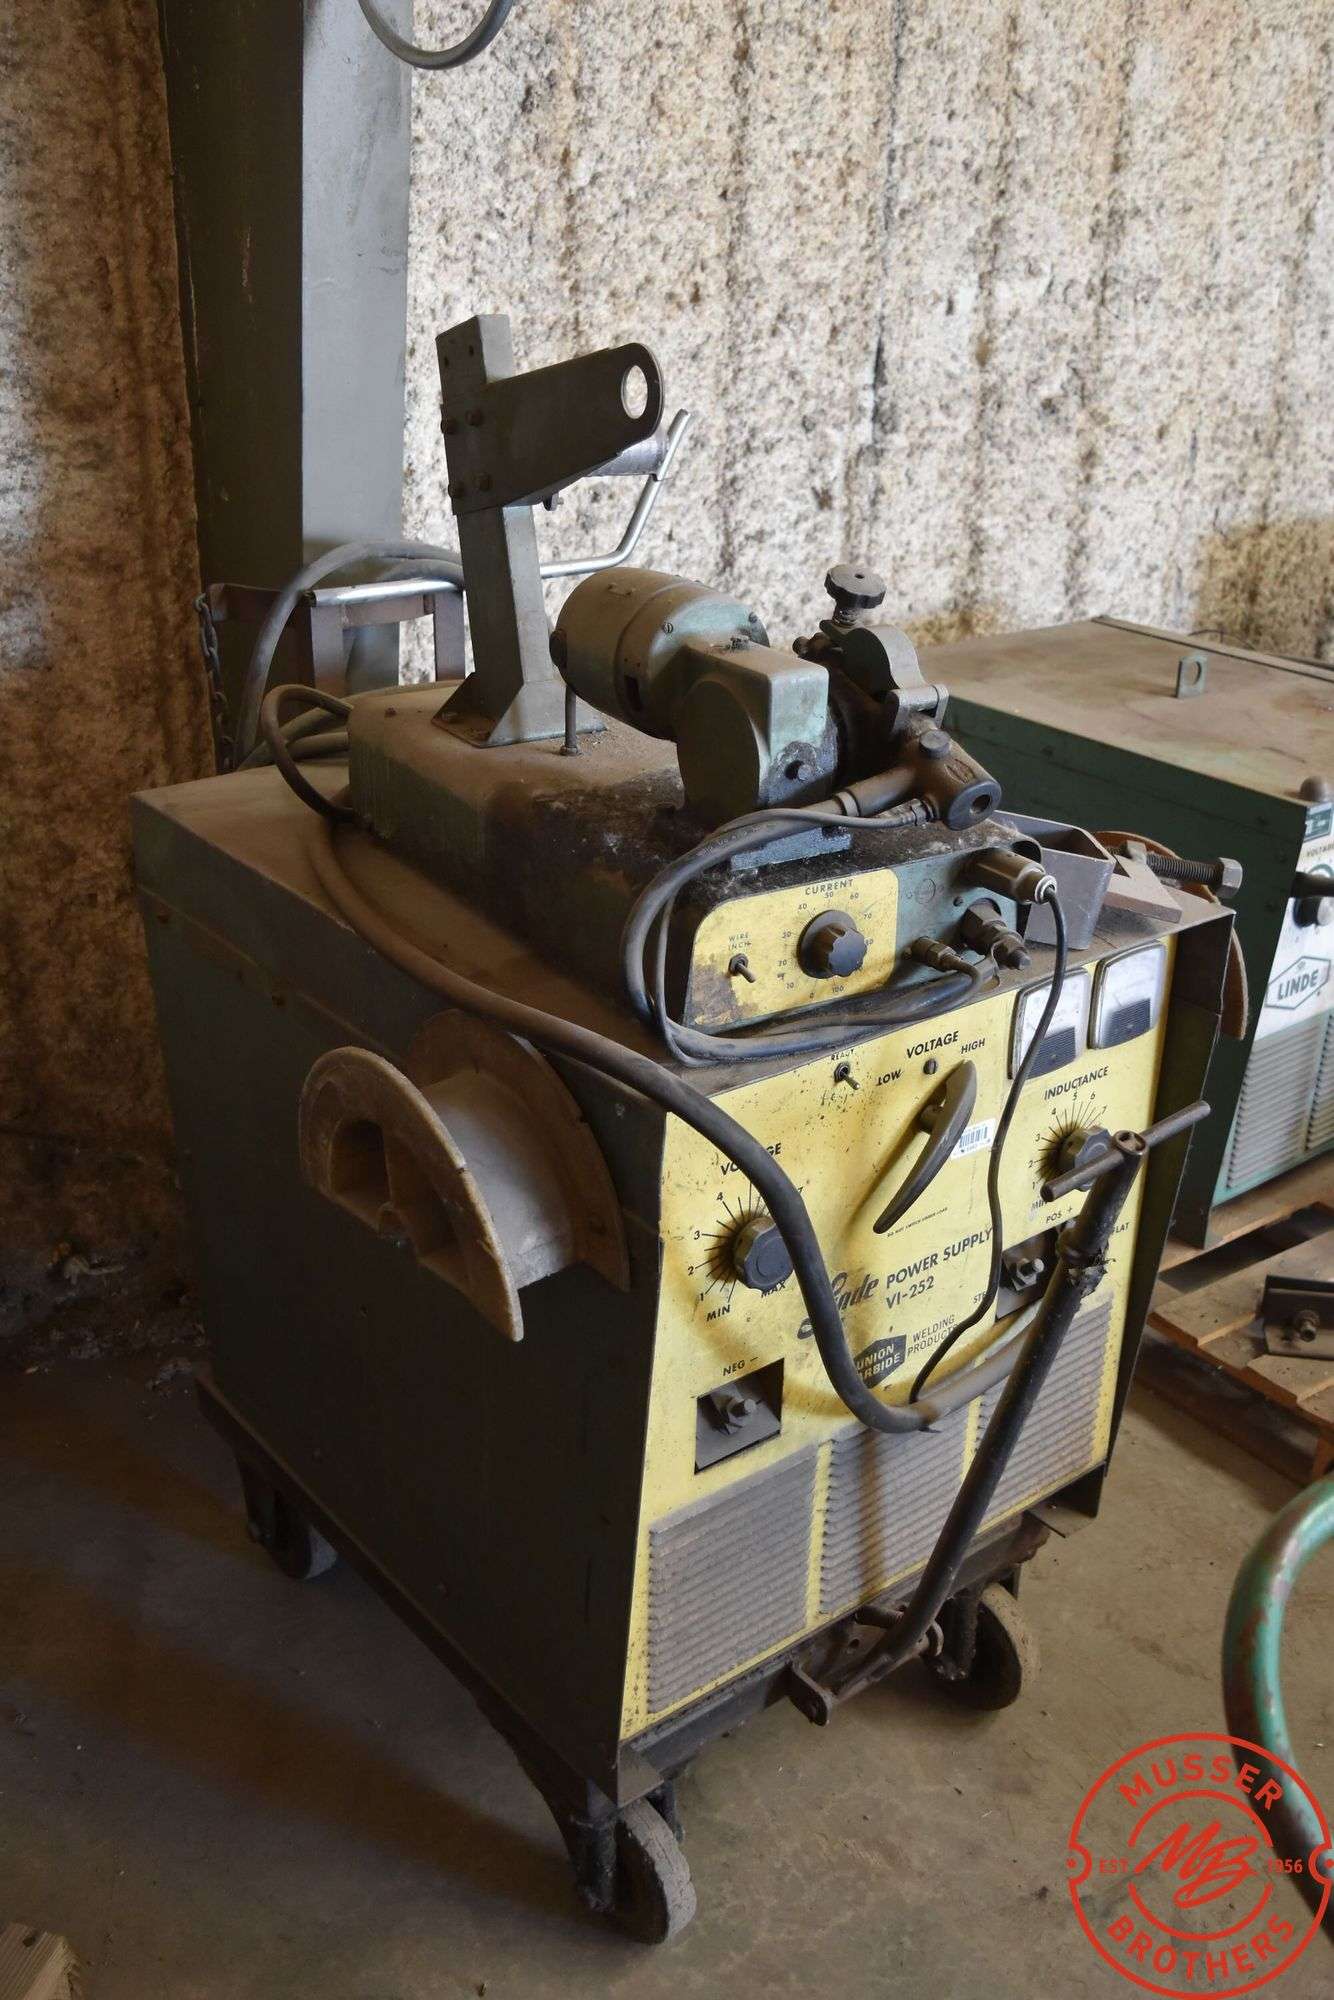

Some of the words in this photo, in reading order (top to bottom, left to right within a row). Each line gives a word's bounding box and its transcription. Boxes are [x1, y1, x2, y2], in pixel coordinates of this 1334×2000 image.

[805, 879, 854, 896] CURRENT
[825, 891, 834, 899] 50
[729, 932, 749, 941] WIRE
[1277, 968, 1319, 1001] LINDE
[905, 1030, 960, 1059] VOLTAGE
[960, 1037, 986, 1055] HIGH
[876, 1069, 904, 1086] LOW
[1043, 1065, 1109, 1101] INDUCTANCE
[1090, 1091, 1096, 1100] 6
[1051, 1107, 1057, 1115] 4
[1102, 1104, 1107, 1114] 7
[1035, 1133, 1041, 1142] 3
[720, 1143, 781, 1176] VOGE
[1028, 1159, 1034, 1169] 2
[717, 1191, 723, 1201] 4
[1046, 1211, 1062, 1224] POS
[694, 1230, 701, 1240] 3
[1113, 1222, 1130, 1233] LAT
[688, 1267, 694, 1276] 2
[797, 1272, 880, 1340] Lnde
[886, 1252, 939, 1289] POWER
[943, 1227, 993, 1260] SUPPLY
[886, 1275, 935, 1310] VI-252
[706, 1304, 731, 1322] MIN
[912, 1313, 956, 1342] WELDING
[907, 1323, 958, 1356] PRODUCT
[856, 1343, 895, 1370] UNION
[723, 1359, 746, 1378] NEG
[856, 1352, 901, 1380] RBIDE
